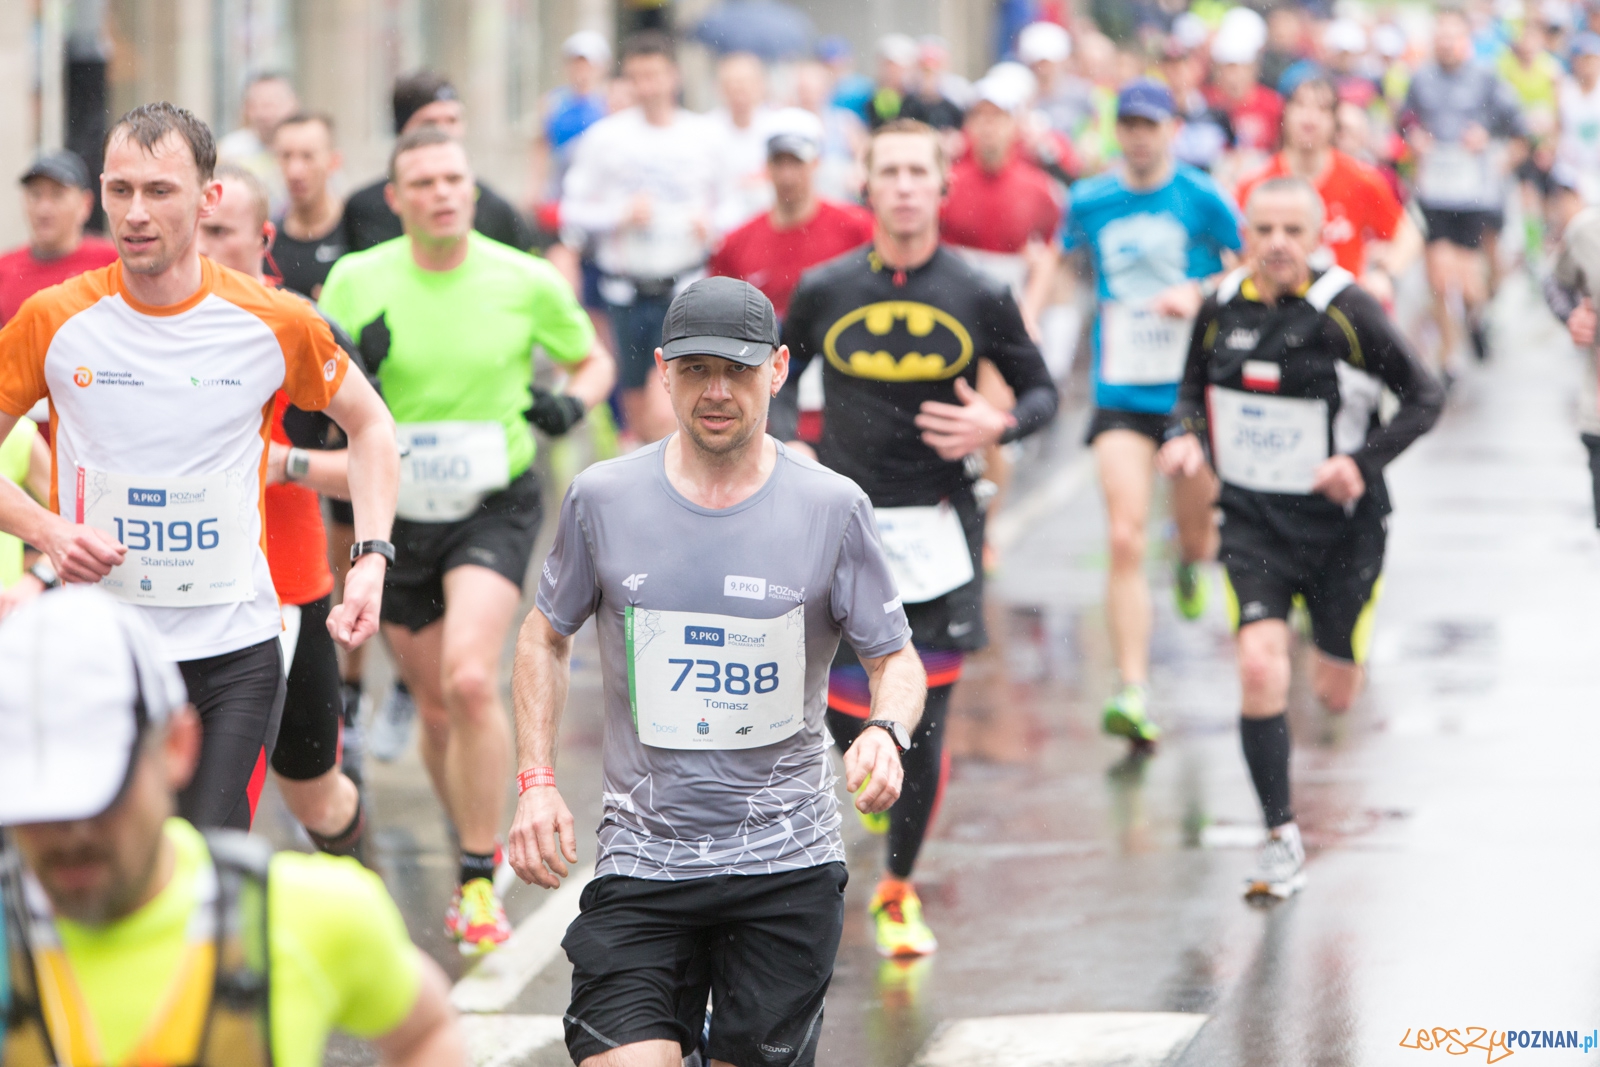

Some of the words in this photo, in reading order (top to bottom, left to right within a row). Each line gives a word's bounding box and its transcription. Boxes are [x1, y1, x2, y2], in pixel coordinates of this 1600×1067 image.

[141, 493, 161, 503] PKO
[113, 517, 219, 552] 13196
[140, 556, 194, 567] Stanisław
[622, 573, 648, 591] 4F
[730, 582, 738, 592] 9.
[739, 583, 760, 593] PKO
[690, 631, 698, 641] 9.
[699, 632, 720, 642] PKO
[668, 658, 780, 696] 7388
[703, 698, 749, 711] Tomasz
[735, 726, 754, 735] 4F
